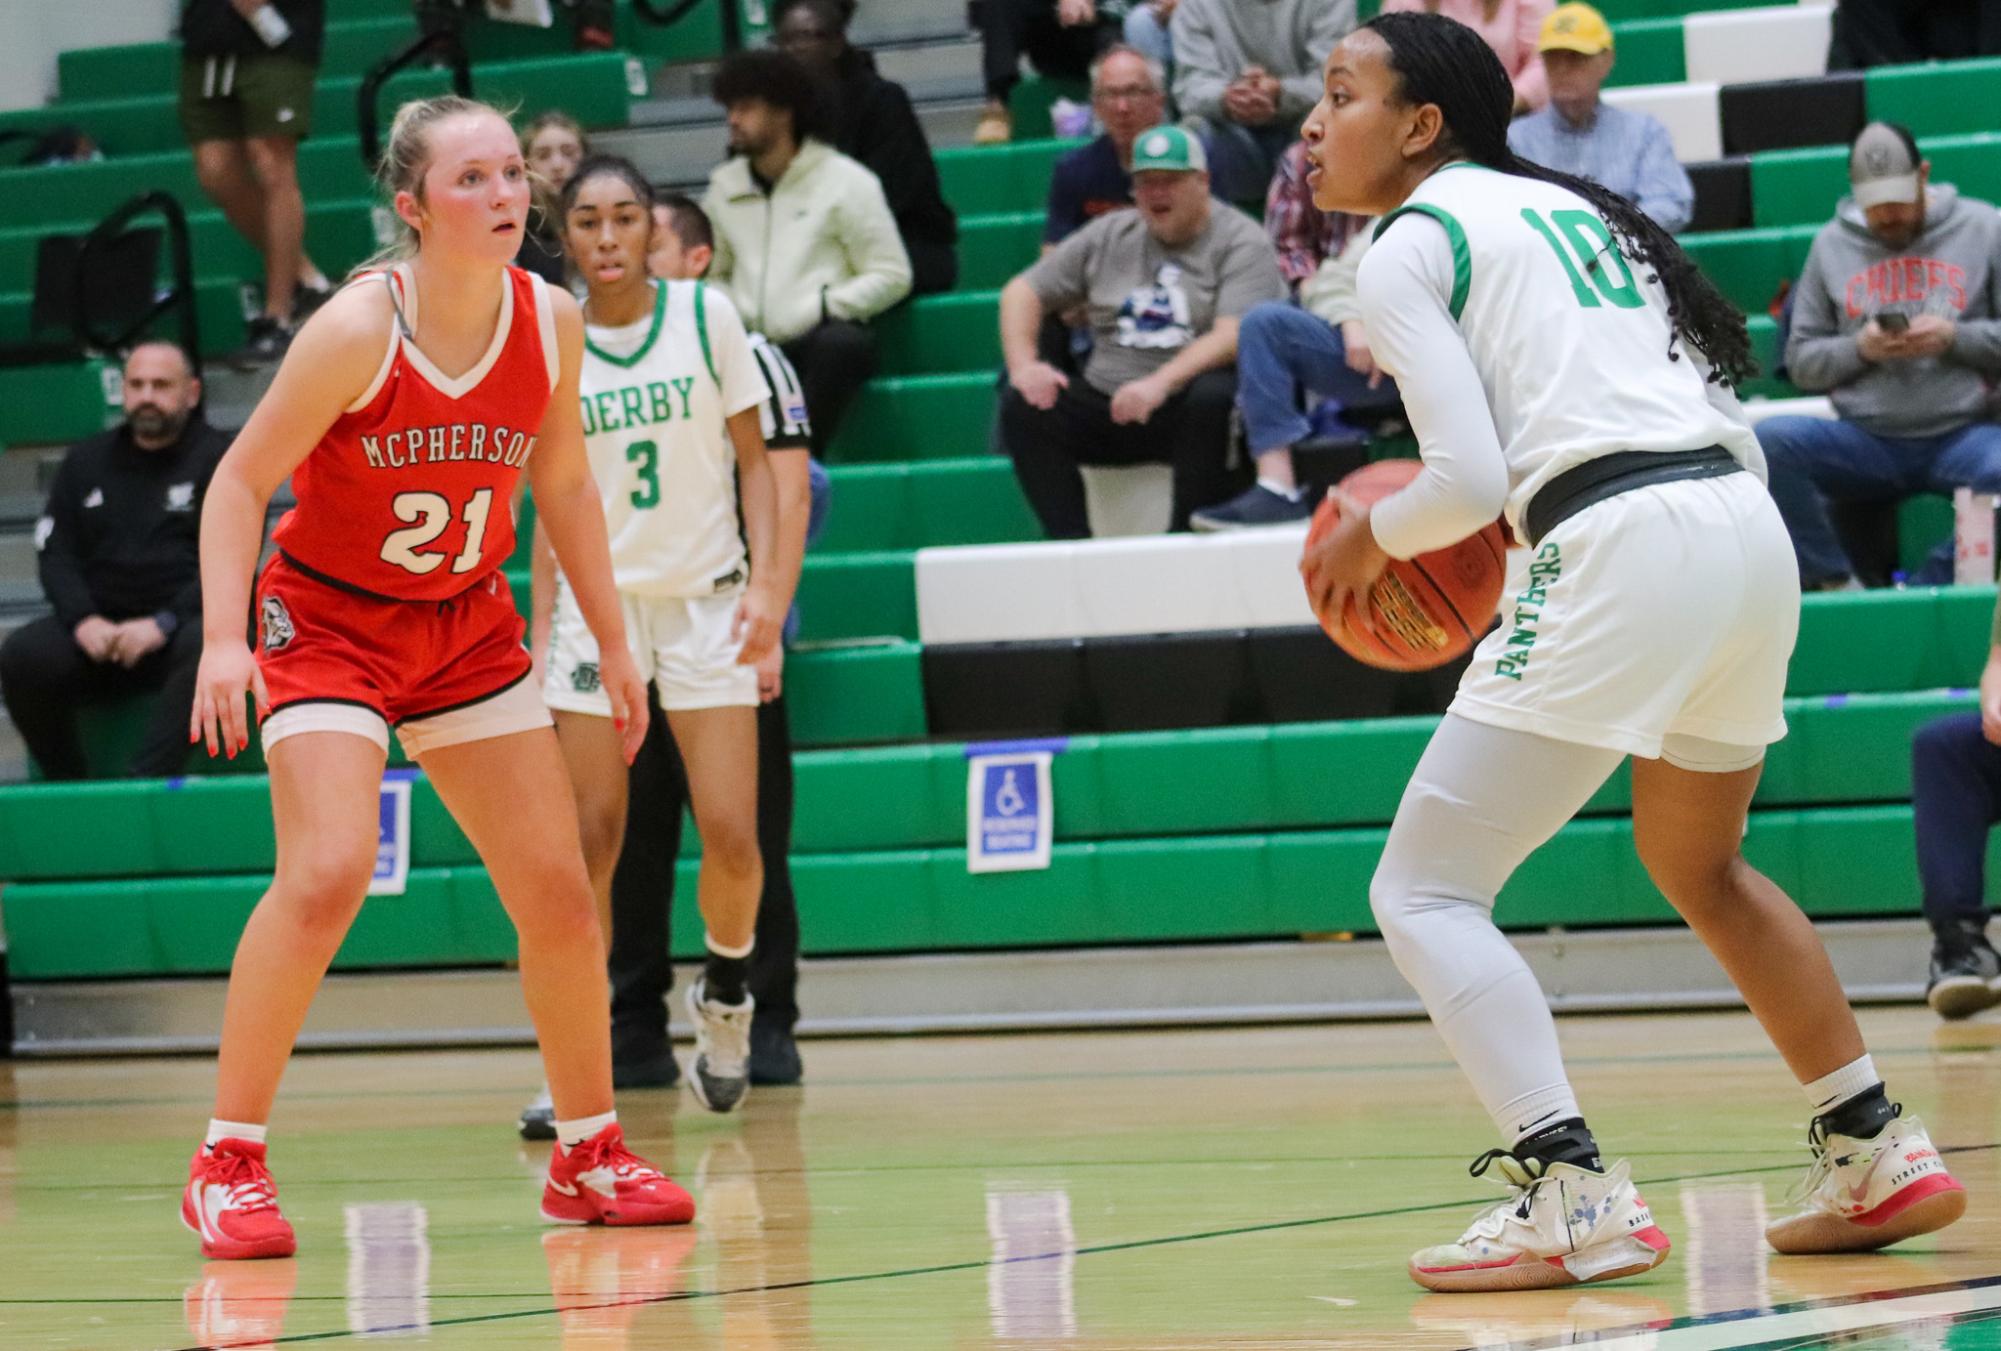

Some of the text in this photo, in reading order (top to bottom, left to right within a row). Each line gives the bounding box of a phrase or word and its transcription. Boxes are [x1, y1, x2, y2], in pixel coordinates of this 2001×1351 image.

[1520, 208, 1648, 309] 10
[1845, 256, 1969, 320] CHIEFS
[580, 376, 695, 438] DERBY
[625, 439, 661, 511] 3
[379, 485, 494, 575] 21
[1494, 542, 1562, 681] PANTHERS
[1890, 1163, 1929, 1186] STREET
